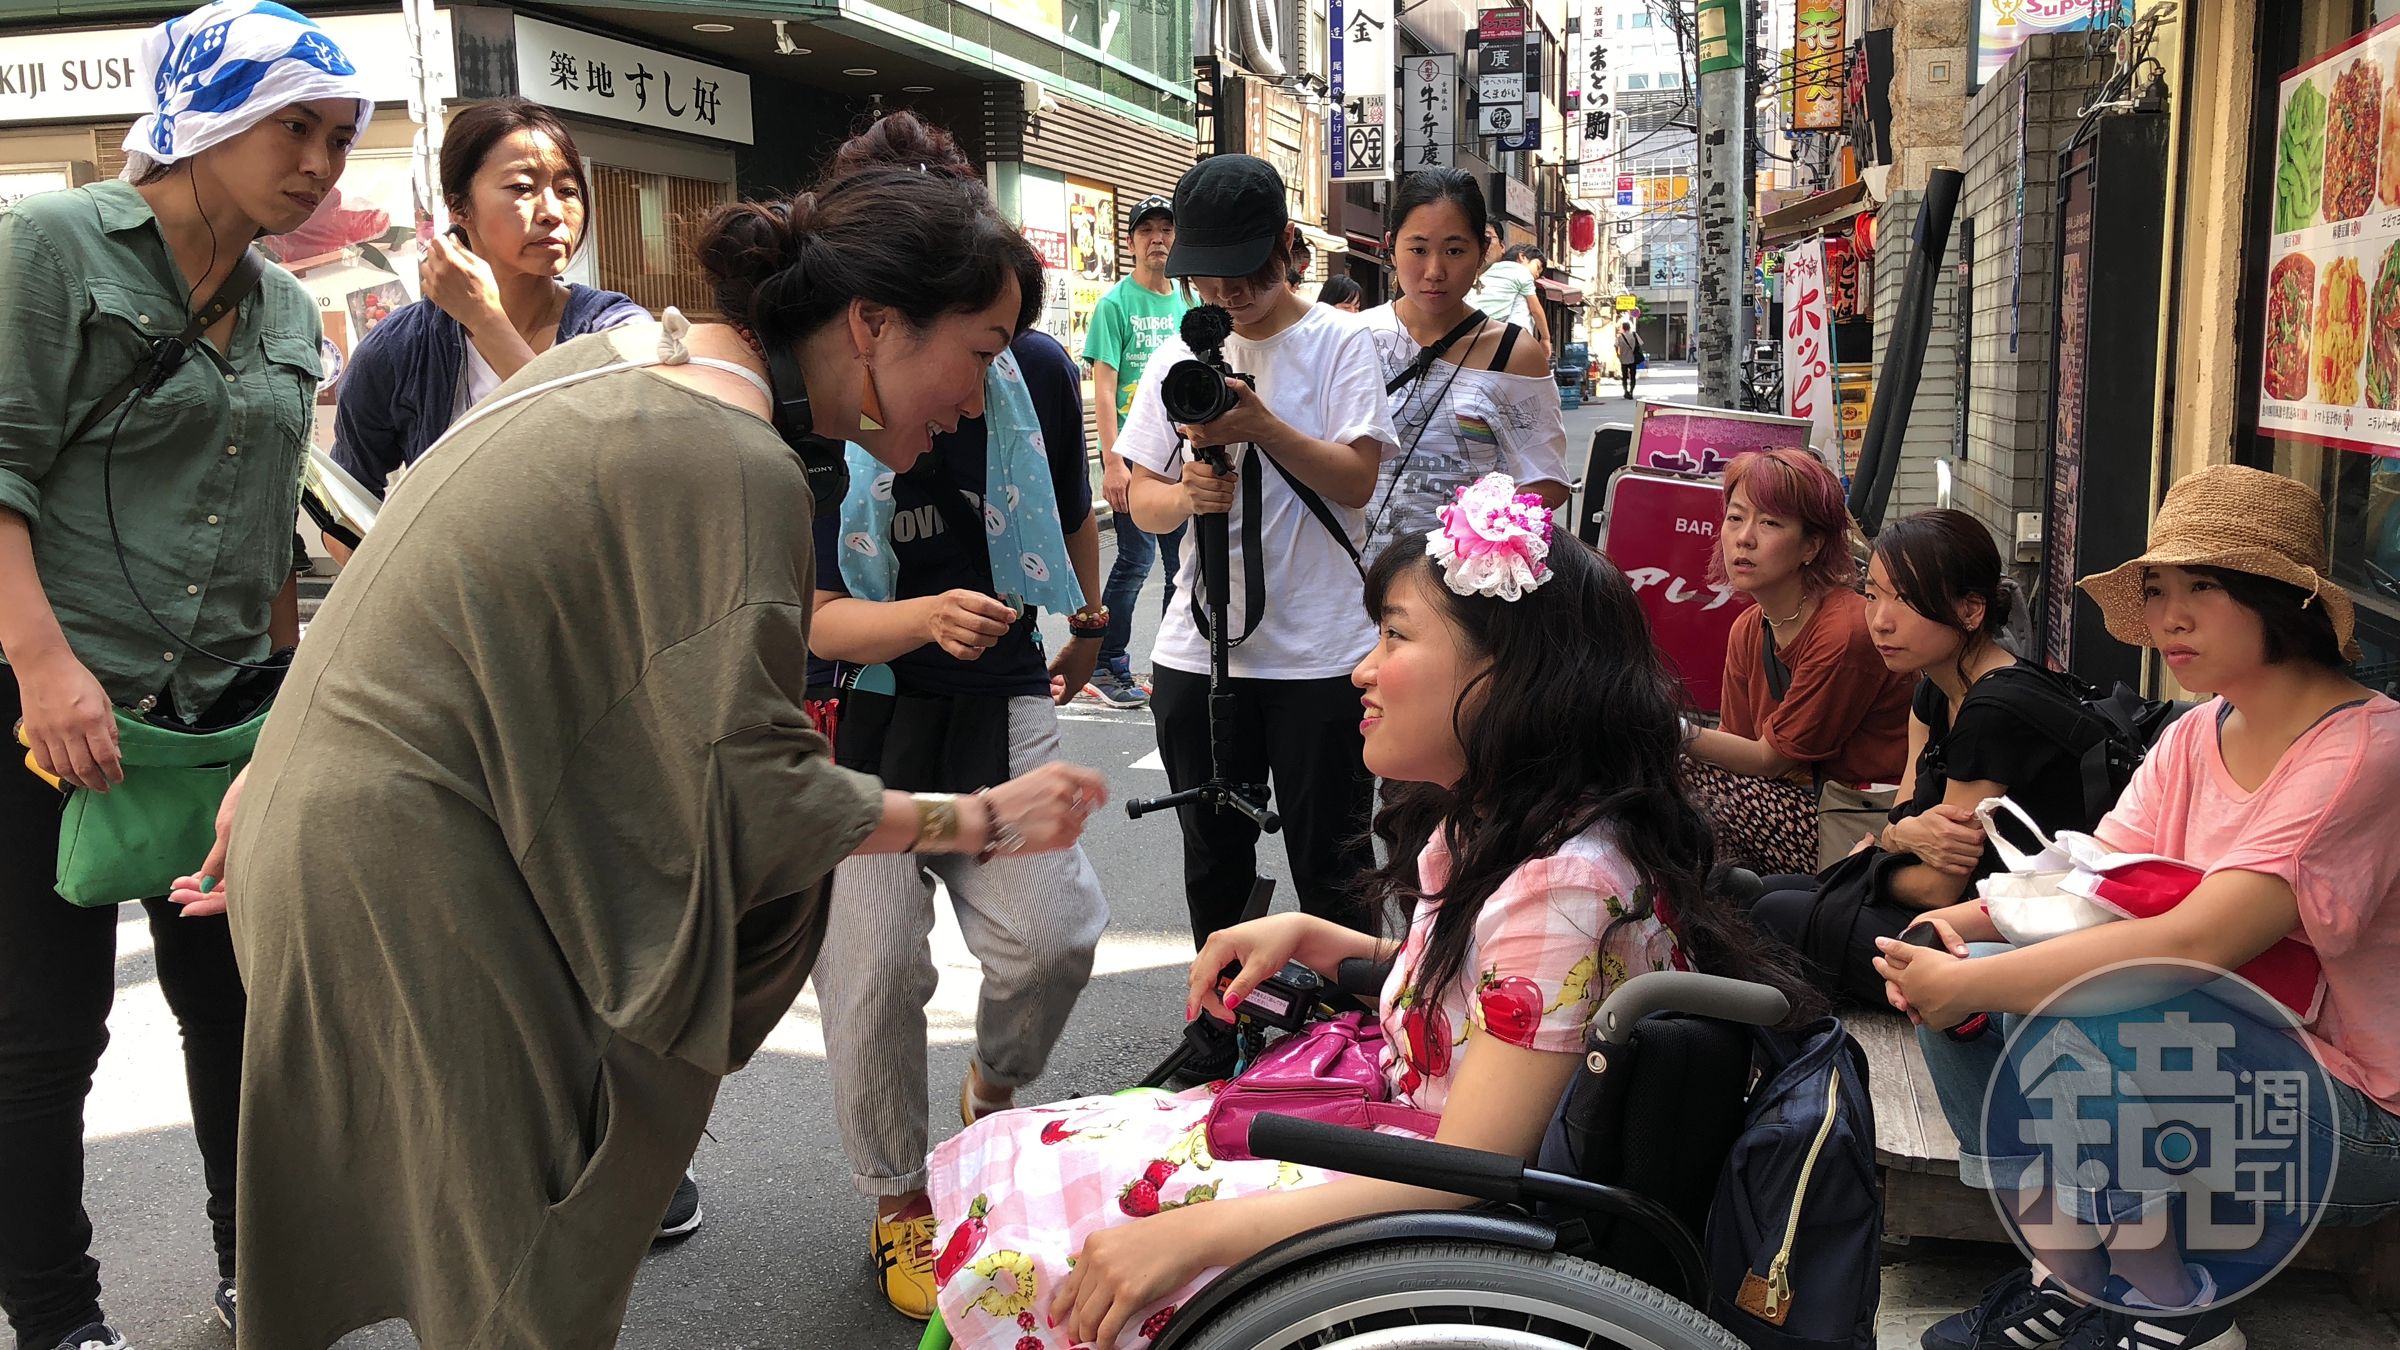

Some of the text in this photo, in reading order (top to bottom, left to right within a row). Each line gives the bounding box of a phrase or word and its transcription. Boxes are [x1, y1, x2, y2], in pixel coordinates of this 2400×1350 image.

[549, 49, 722, 126] 築地すし好
[1418, 82, 1442, 166] 牛弁慶
[808, 466, 833, 474] SONY
[1675, 517, 1714, 537] BAR
